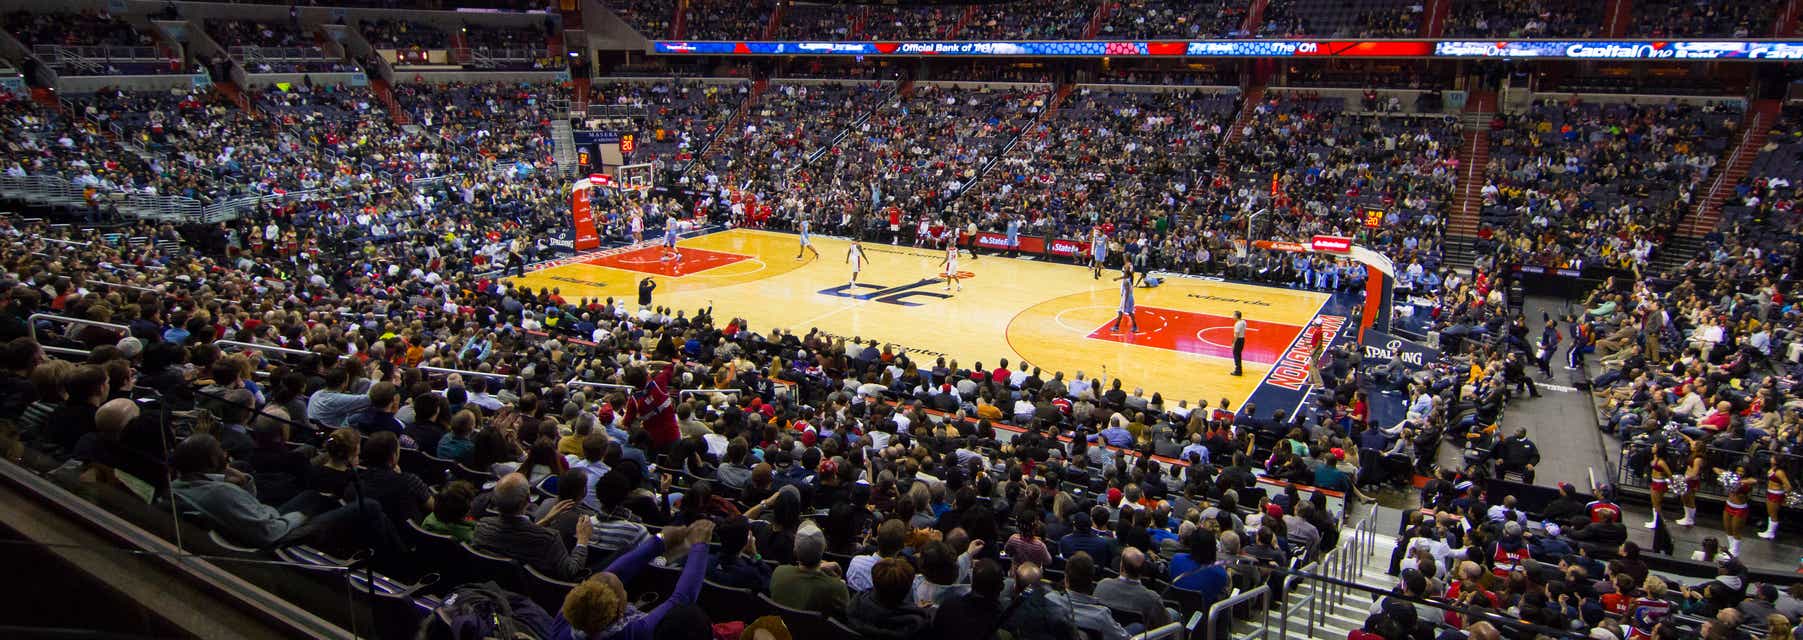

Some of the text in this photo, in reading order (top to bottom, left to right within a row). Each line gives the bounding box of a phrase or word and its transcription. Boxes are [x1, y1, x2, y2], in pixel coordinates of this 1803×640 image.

[902, 43, 935, 52] Official
[935, 43, 961, 52] Bank
[962, 43, 973, 52] of
[1272, 42, 1296, 52] The
[622, 140, 633, 150] 20
[1367, 216, 1378, 226] 20
[1363, 345, 1423, 367] SPALING
